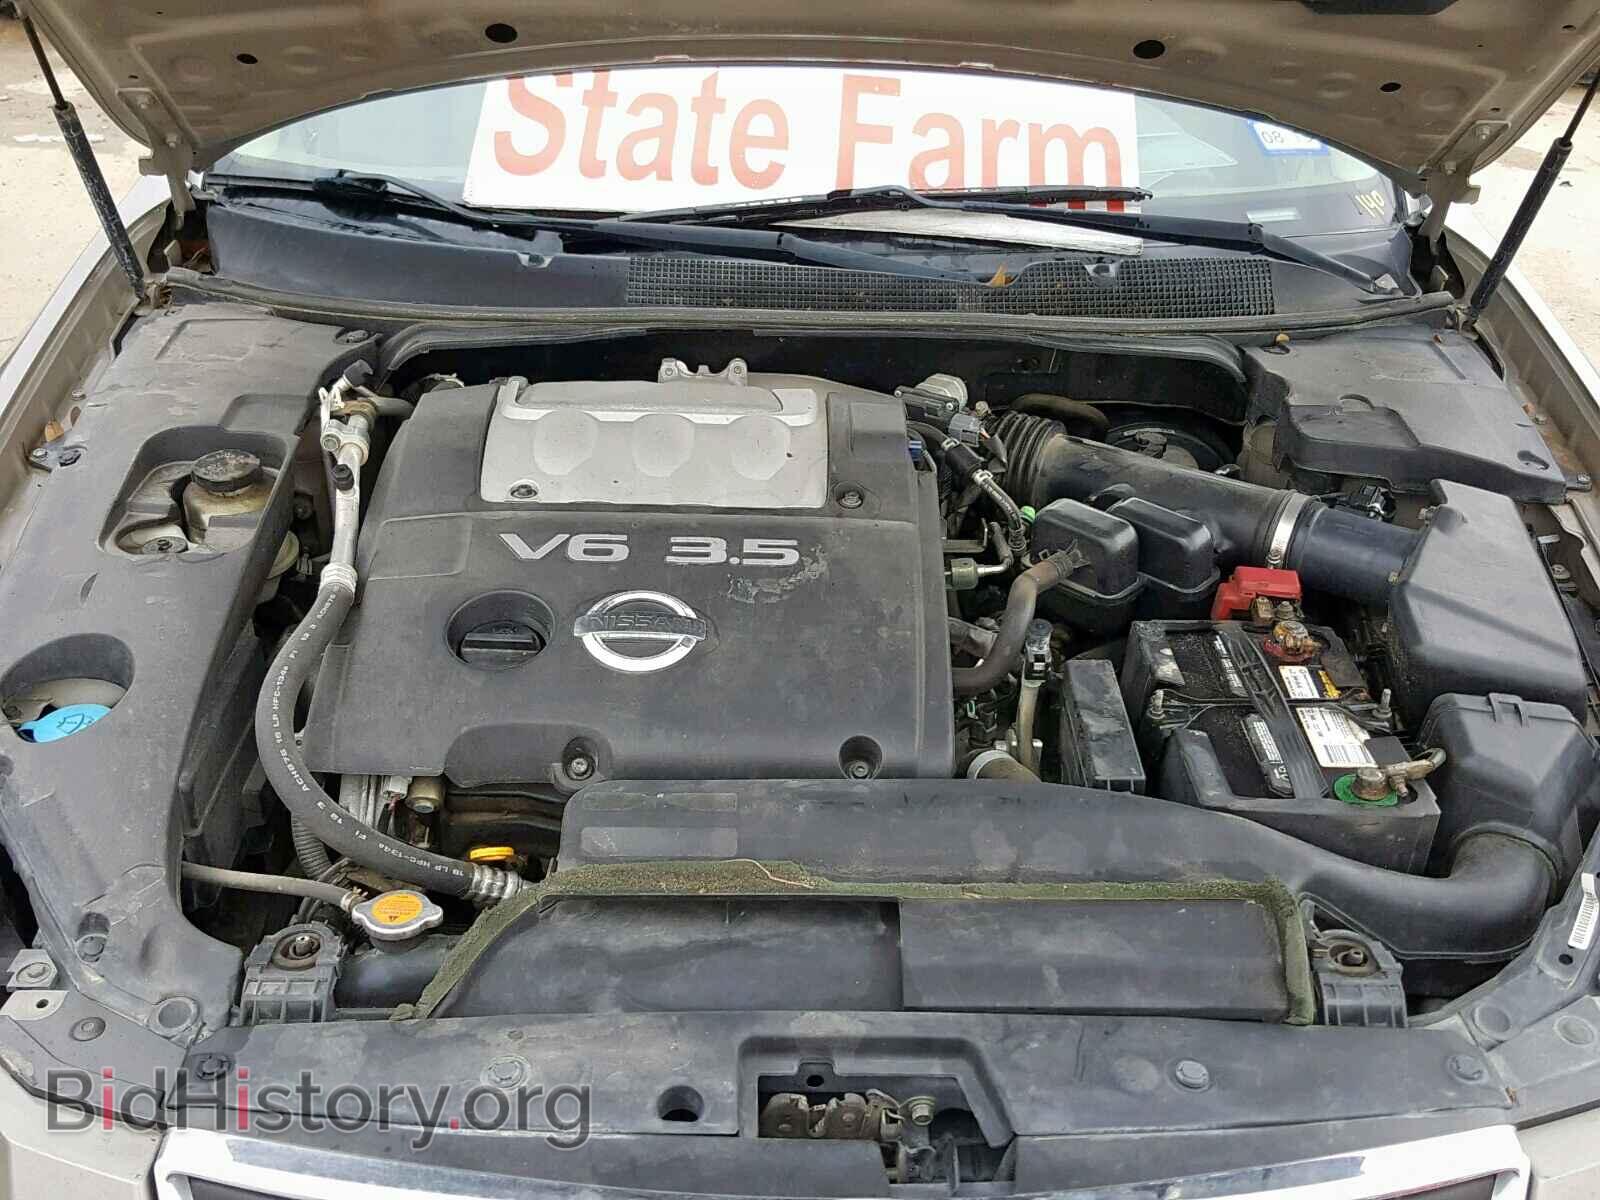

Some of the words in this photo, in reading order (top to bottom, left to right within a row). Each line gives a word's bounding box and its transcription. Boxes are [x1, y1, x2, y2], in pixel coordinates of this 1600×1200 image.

[494, 71, 789, 190] State
[835, 74, 1125, 212] Farm
[499, 533, 630, 562] V6
[664, 536, 800, 566] 3.5
